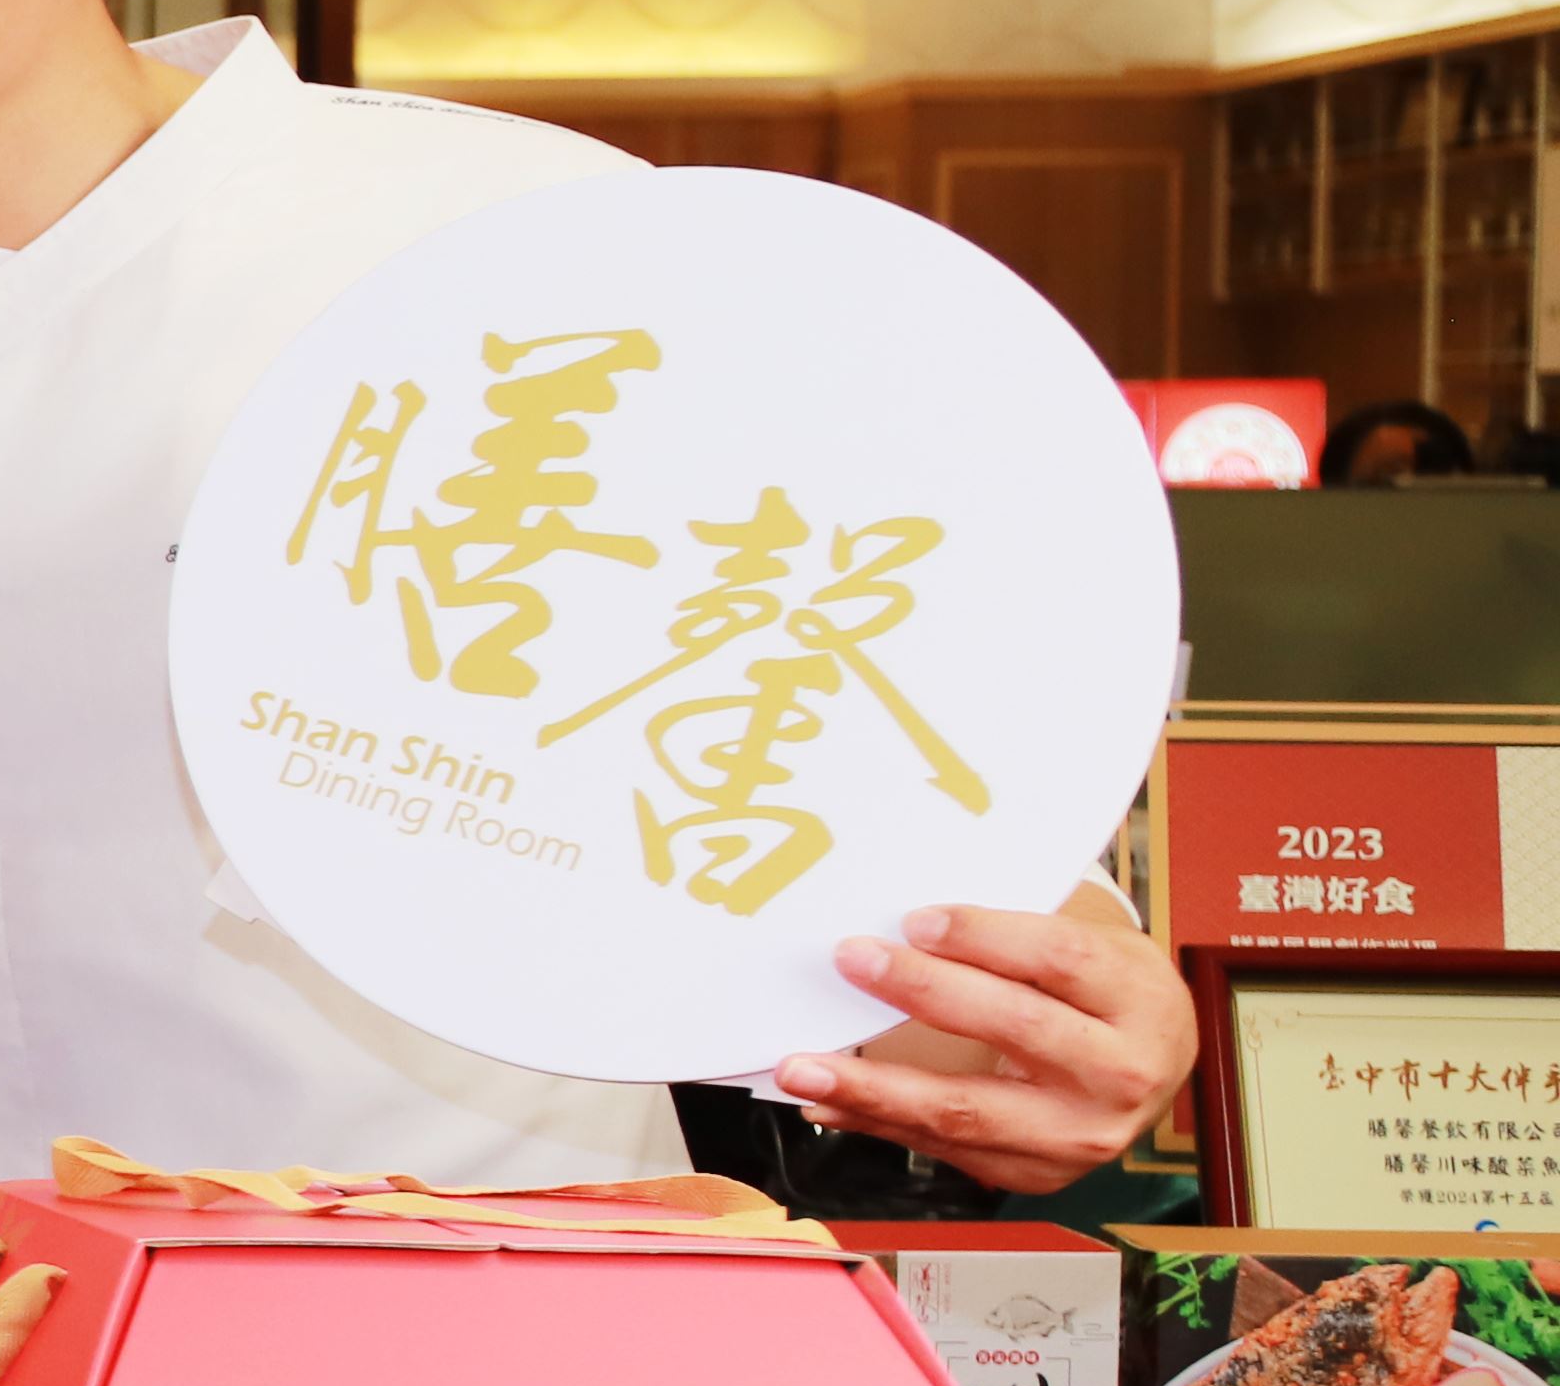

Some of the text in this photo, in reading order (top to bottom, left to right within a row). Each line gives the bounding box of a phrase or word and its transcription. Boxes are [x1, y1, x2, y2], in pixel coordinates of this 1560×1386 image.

[283, 326, 994, 917] 膳馨
[239, 690, 517, 805] Shan Shin
[277, 750, 585, 873] Dining Room
[1276, 825, 1385, 861] 2023
[1237, 874, 1416, 916] 臺灣好食
